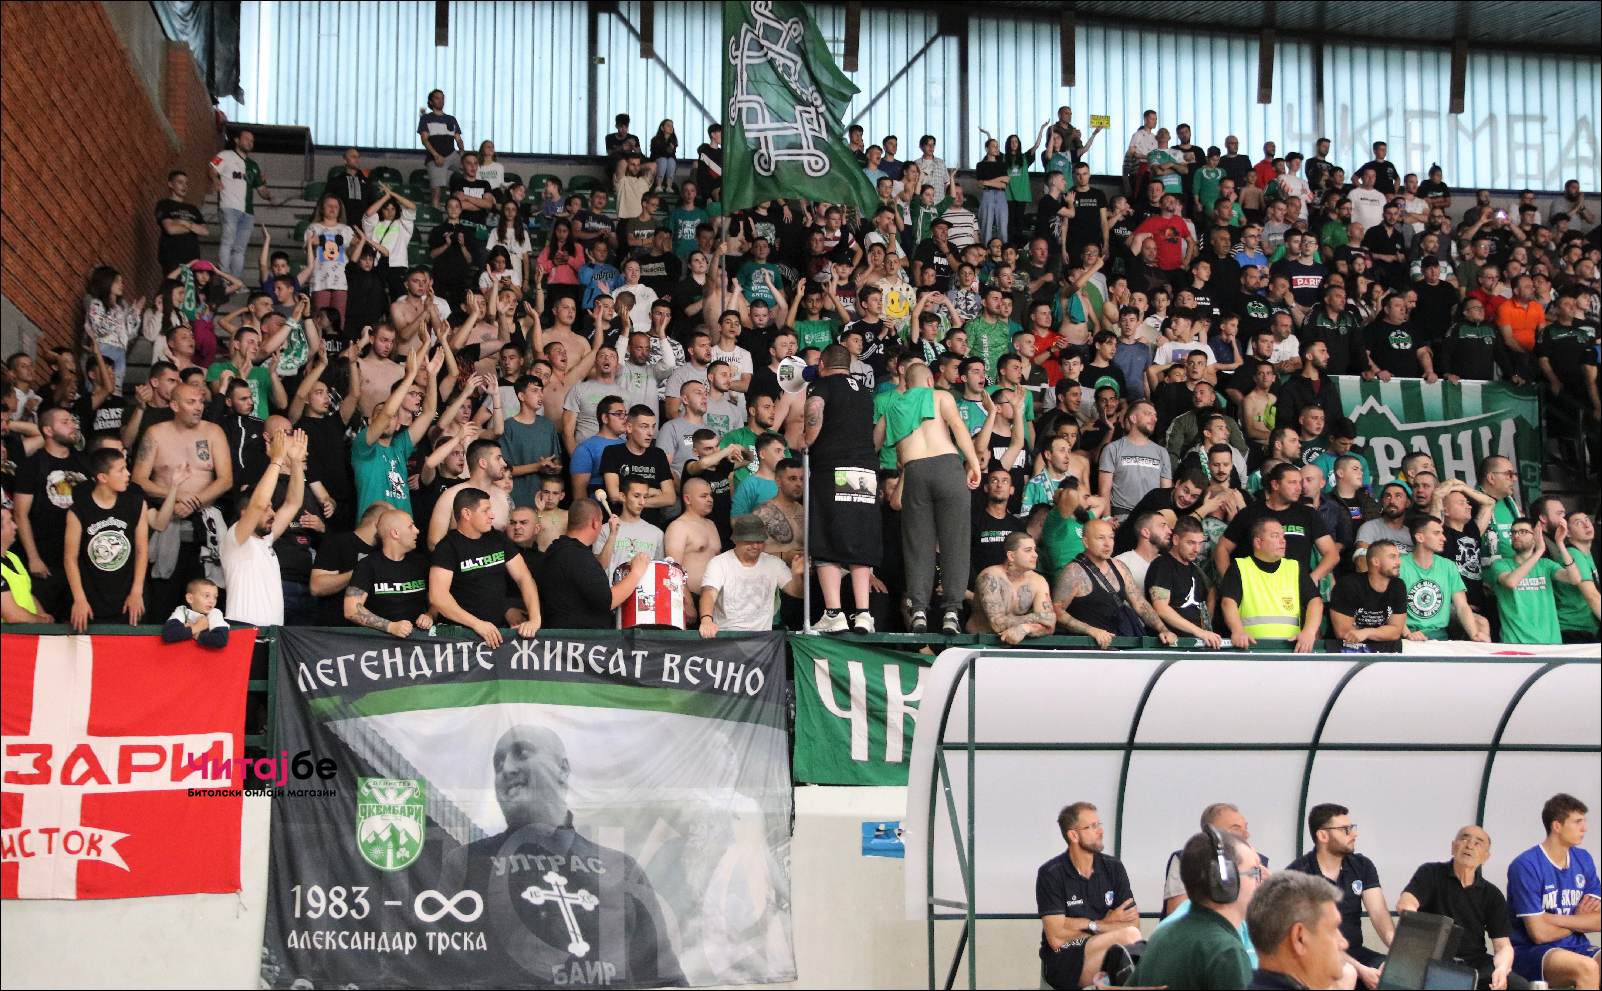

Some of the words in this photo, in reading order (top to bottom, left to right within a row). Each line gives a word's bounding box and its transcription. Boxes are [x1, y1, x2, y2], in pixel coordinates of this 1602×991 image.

[461, 551, 505, 570] ULTRAS
[374, 580, 426, 593] ULTRAS
[297, 641, 496, 692] ЛЕГЕНДИТЕ
[510, 639, 649, 679] ЖИВЕАТ
[662, 653, 765, 696] ВЕЧНО
[289, 885, 370, 919] 1983
[287, 930, 417, 955] АЛЕКСАНДАР
[425, 930, 488, 955] ТРСКА
[552, 961, 617, 986] БАИР
